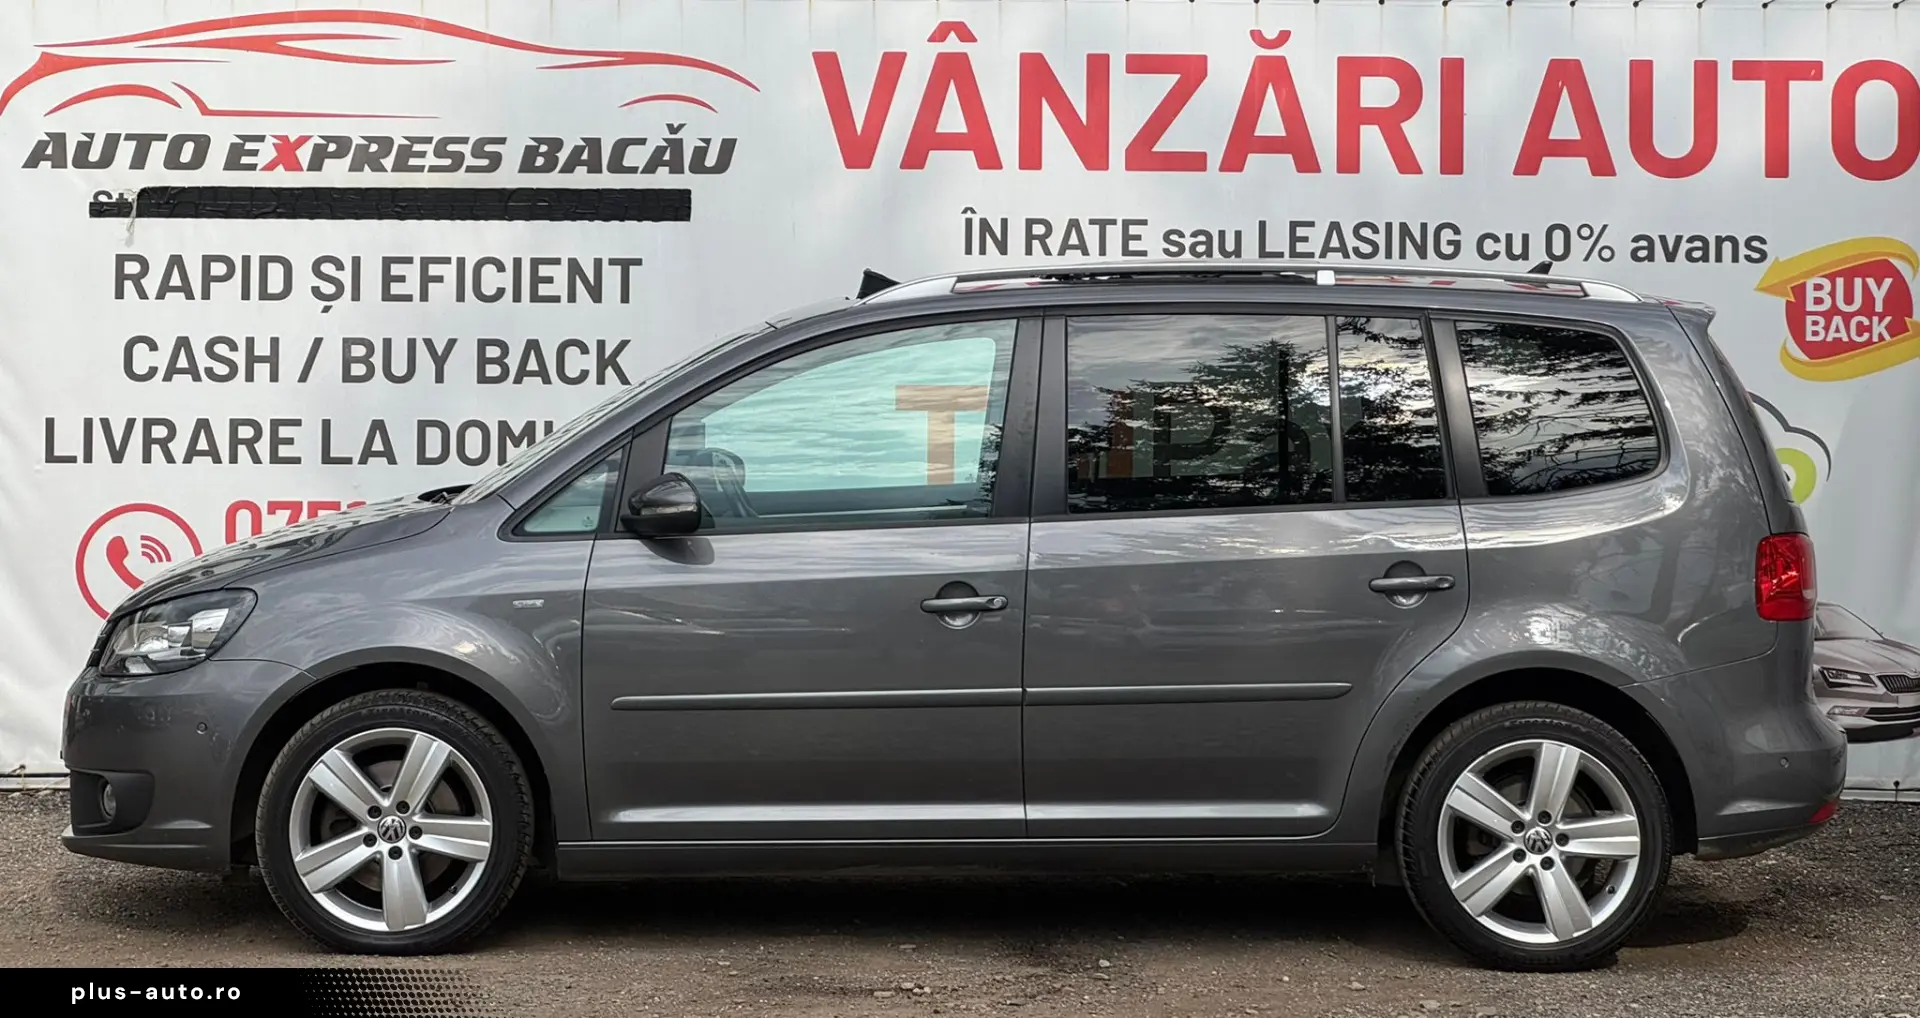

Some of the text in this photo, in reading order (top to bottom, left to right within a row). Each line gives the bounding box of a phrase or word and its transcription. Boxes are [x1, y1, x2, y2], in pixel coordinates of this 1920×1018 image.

[811, 20, 1920, 181] VÂNZĂRI AUTO
[22, 132, 211, 170] AUTO
[223, 134, 507, 173] EXPRESS
[961, 207, 1769, 264] ÎN RATE sau LEASING cu 0% avans
[115, 254, 293, 301] RAPID
[381, 257, 643, 304] EFICIENT
[1805, 277, 1893, 312] BUY
[1805, 316, 1892, 342] BACK
[123, 336, 633, 386] CASH / BUY BACK
[44, 418, 303, 465] LIVRARE
[320, 419, 398, 466] LA
